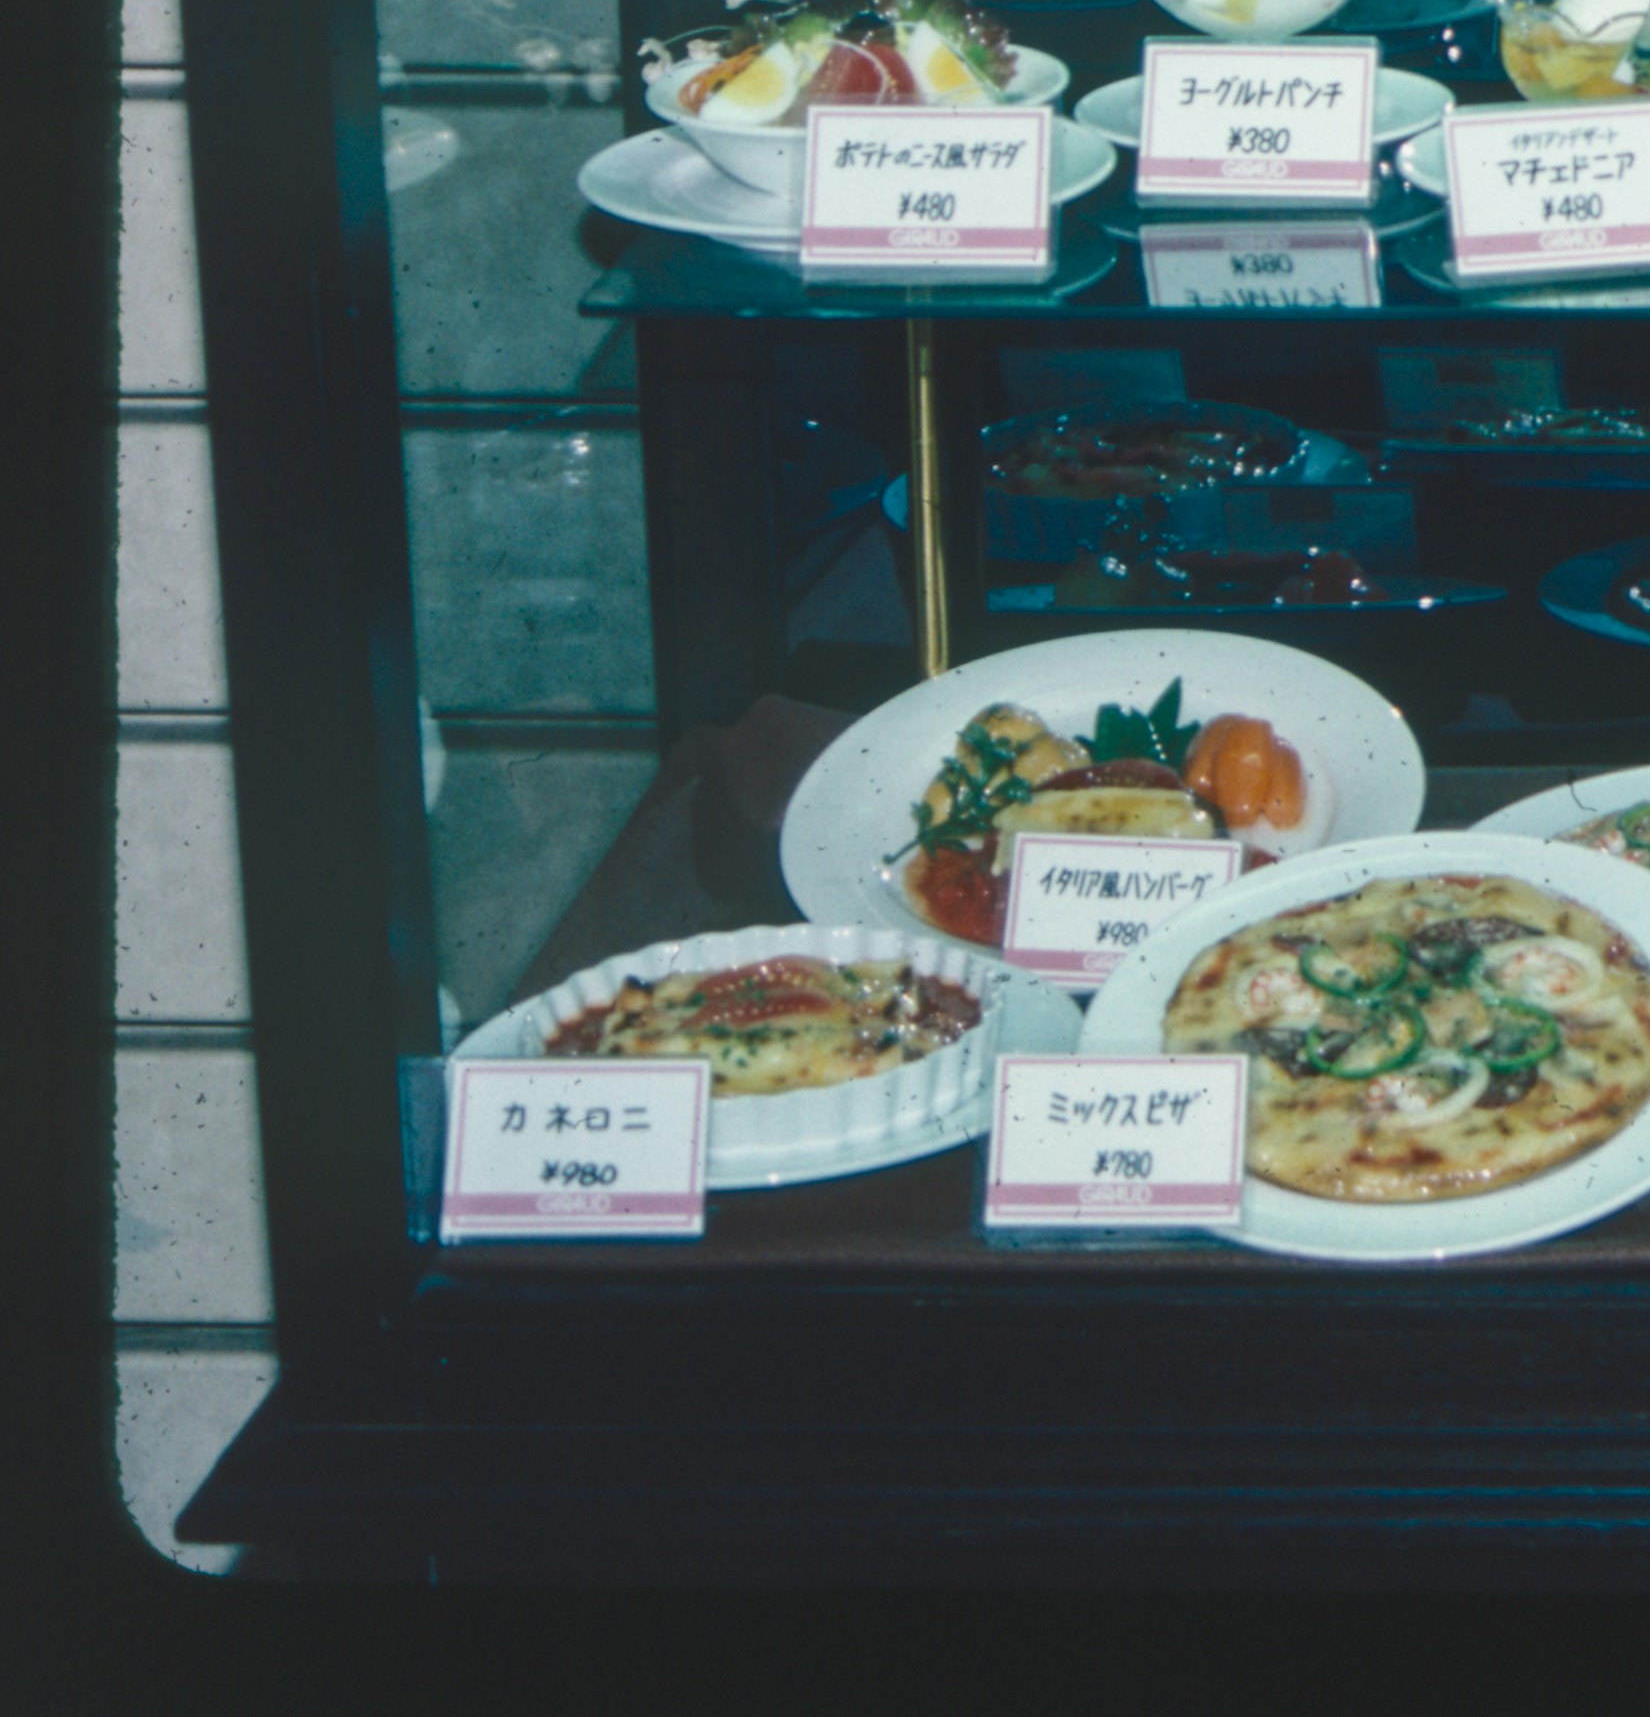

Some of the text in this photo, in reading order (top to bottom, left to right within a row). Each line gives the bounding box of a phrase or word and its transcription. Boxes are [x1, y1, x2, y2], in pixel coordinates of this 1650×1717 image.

[1178, 76, 1344, 109] ヨーグルトパンチ
[1226, 127, 1291, 154] ¥380
[1496, 151, 1635, 187] マチェドニア
[899, 192, 956, 221] ¥480
[1541, 193, 1604, 222] ¥480
[1039, 864, 1215, 902] イタリア風ハンバーグ
[500, 1102, 652, 1134] カネロニ
[1047, 1089, 1203, 1127] ミックスピザ
[539, 1159, 620, 1188] ¥980
[1092, 1149, 1154, 1179] ¥780
